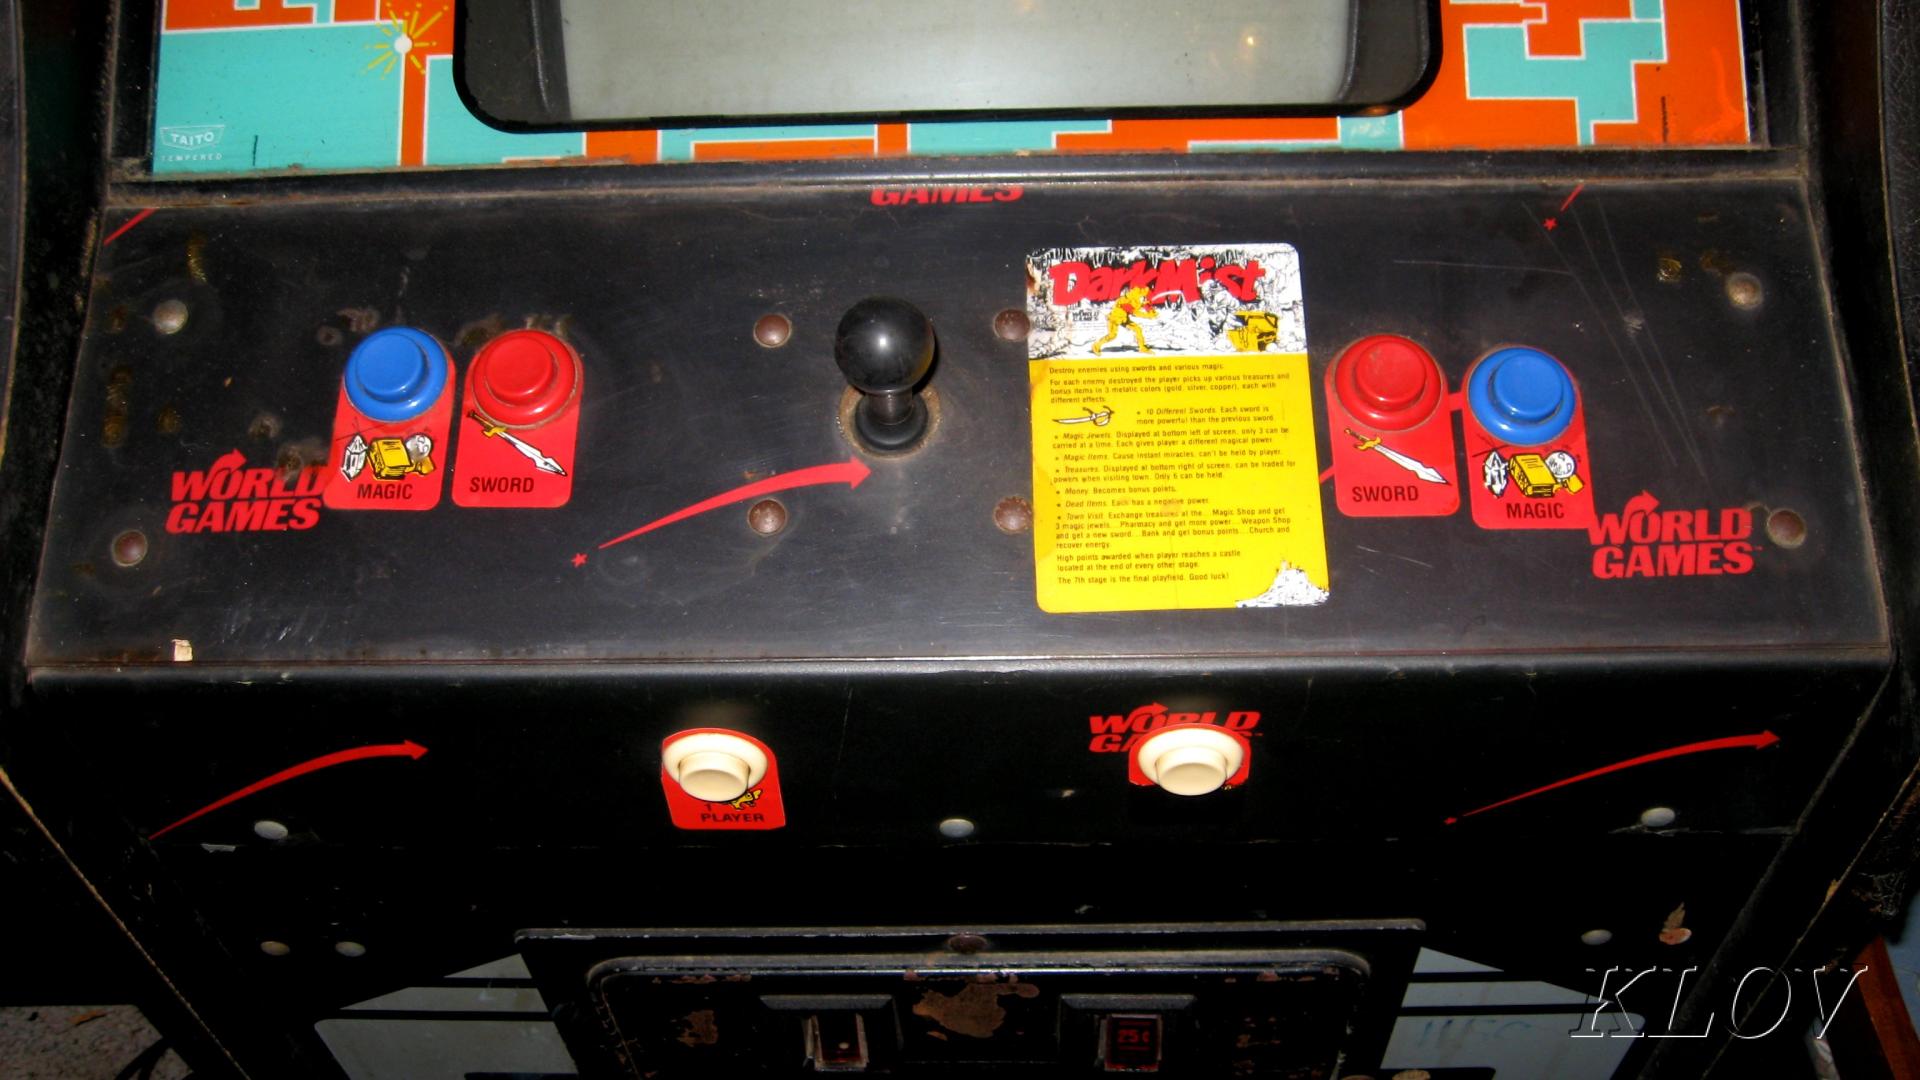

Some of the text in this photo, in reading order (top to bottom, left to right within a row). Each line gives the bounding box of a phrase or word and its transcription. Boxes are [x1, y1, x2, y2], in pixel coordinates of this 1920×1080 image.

[171, 131, 214, 146] TAITO
[1049, 366, 1075, 375] Destroy
[1078, 365, 1108, 373] enemies
[1110, 364, 1130, 374] using
[1132, 364, 1156, 372] swords
[1174, 363, 1200, 371] various
[1063, 378, 1081, 386] each
[1082, 378, 1106, 387] enemy
[1108, 376, 1142, 386] destroyed
[1158, 375, 1180, 385] player
[1182, 375, 1201, 384] picks
[1215, 373, 1241, 382] various
[1242, 373, 1275, 381] treasures
[1050, 387, 1072, 395] bonus
[1074, 386, 1093, 395] items
[1140, 384, 1161, 393] colors
[1242, 381, 1259, 390] each
[1261, 381, 1277, 389] with
[1050, 396, 1080, 404] different
[1156, 407, 1187, 415] Different
[1220, 406, 1238, 414] Each
[1239, 405, 1261, 413] sword
[1157, 416, 1188, 426] powerful
[1190, 415, 1206, 423] than
[1221, 414, 1251, 424] previous
[1063, 431, 1084, 441] Magic
[1116, 429, 1151, 439] Displayed
[1162, 428, 1188, 437] bottom
[1189, 428, 1201, 436] left
[1241, 427, 1257, 436] only
[1052, 441, 1077, 449] carried
[1116, 439, 1134, 448] Each
[1135, 439, 1155, 448] gives
[1157, 438, 1179, 448] player
[1188, 437, 1218, 446] different
[1221, 436, 1249, 446] magical
[1063, 453, 1085, 462] Magic
[1113, 451, 1134, 460] Cause
[1137, 451, 1161, 459] instant
[1230, 449, 1246, 457] held
[1103, 463, 1139, 473] Displayed
[1150, 462, 1176, 471] bottom
[1178, 462, 1195, 471] right
[1053, 476, 1079, 484] powers
[1082, 474, 1101, 482] when
[1103, 473, 1130, 483] visiting
[1154, 472, 1170, 482] Only
[356, 483, 414, 500] MAGIC
[469, 476, 535, 494] SWORD
[1093, 486, 1126, 494] Becomes
[1128, 486, 1151, 494] bonus
[1351, 485, 1419, 503] SWORD
[1065, 500, 1084, 508] Dead
[1111, 499, 1129, 507] Each
[164, 498, 322, 534] GAMES
[1066, 512, 1085, 520] Town
[1108, 511, 1143, 521] Exchange
[1212, 508, 1234, 518] Magic
[1236, 507, 1256, 517] Shop
[1505, 502, 1565, 520] MAGIC
[1062, 522, 1085, 531] magic
[1119, 520, 1156, 530] Pharmacy
[1188, 519, 1207, 527] more
[1241, 517, 1271, 526] Weapon
[1272, 516, 1292, 526] Shop
[1588, 508, 1753, 545] WORLD
[1141, 529, 1160, 537] Bank
[1192, 528, 1215, 536] bonus
[1249, 526, 1275, 534] Church
[1056, 550, 1241, 563] High points awarded when player reaches castle
[1592, 541, 1754, 579] GAMES
[1057, 563, 1084, 572] located
[1134, 563, 1155, 571] every
[1157, 561, 1176, 569] other
[1088, 575, 1108, 585] stage
[1133, 574, 1150, 582] final
[1189, 573, 1208, 581] Good
[700, 813, 765, 822] PLAYER
